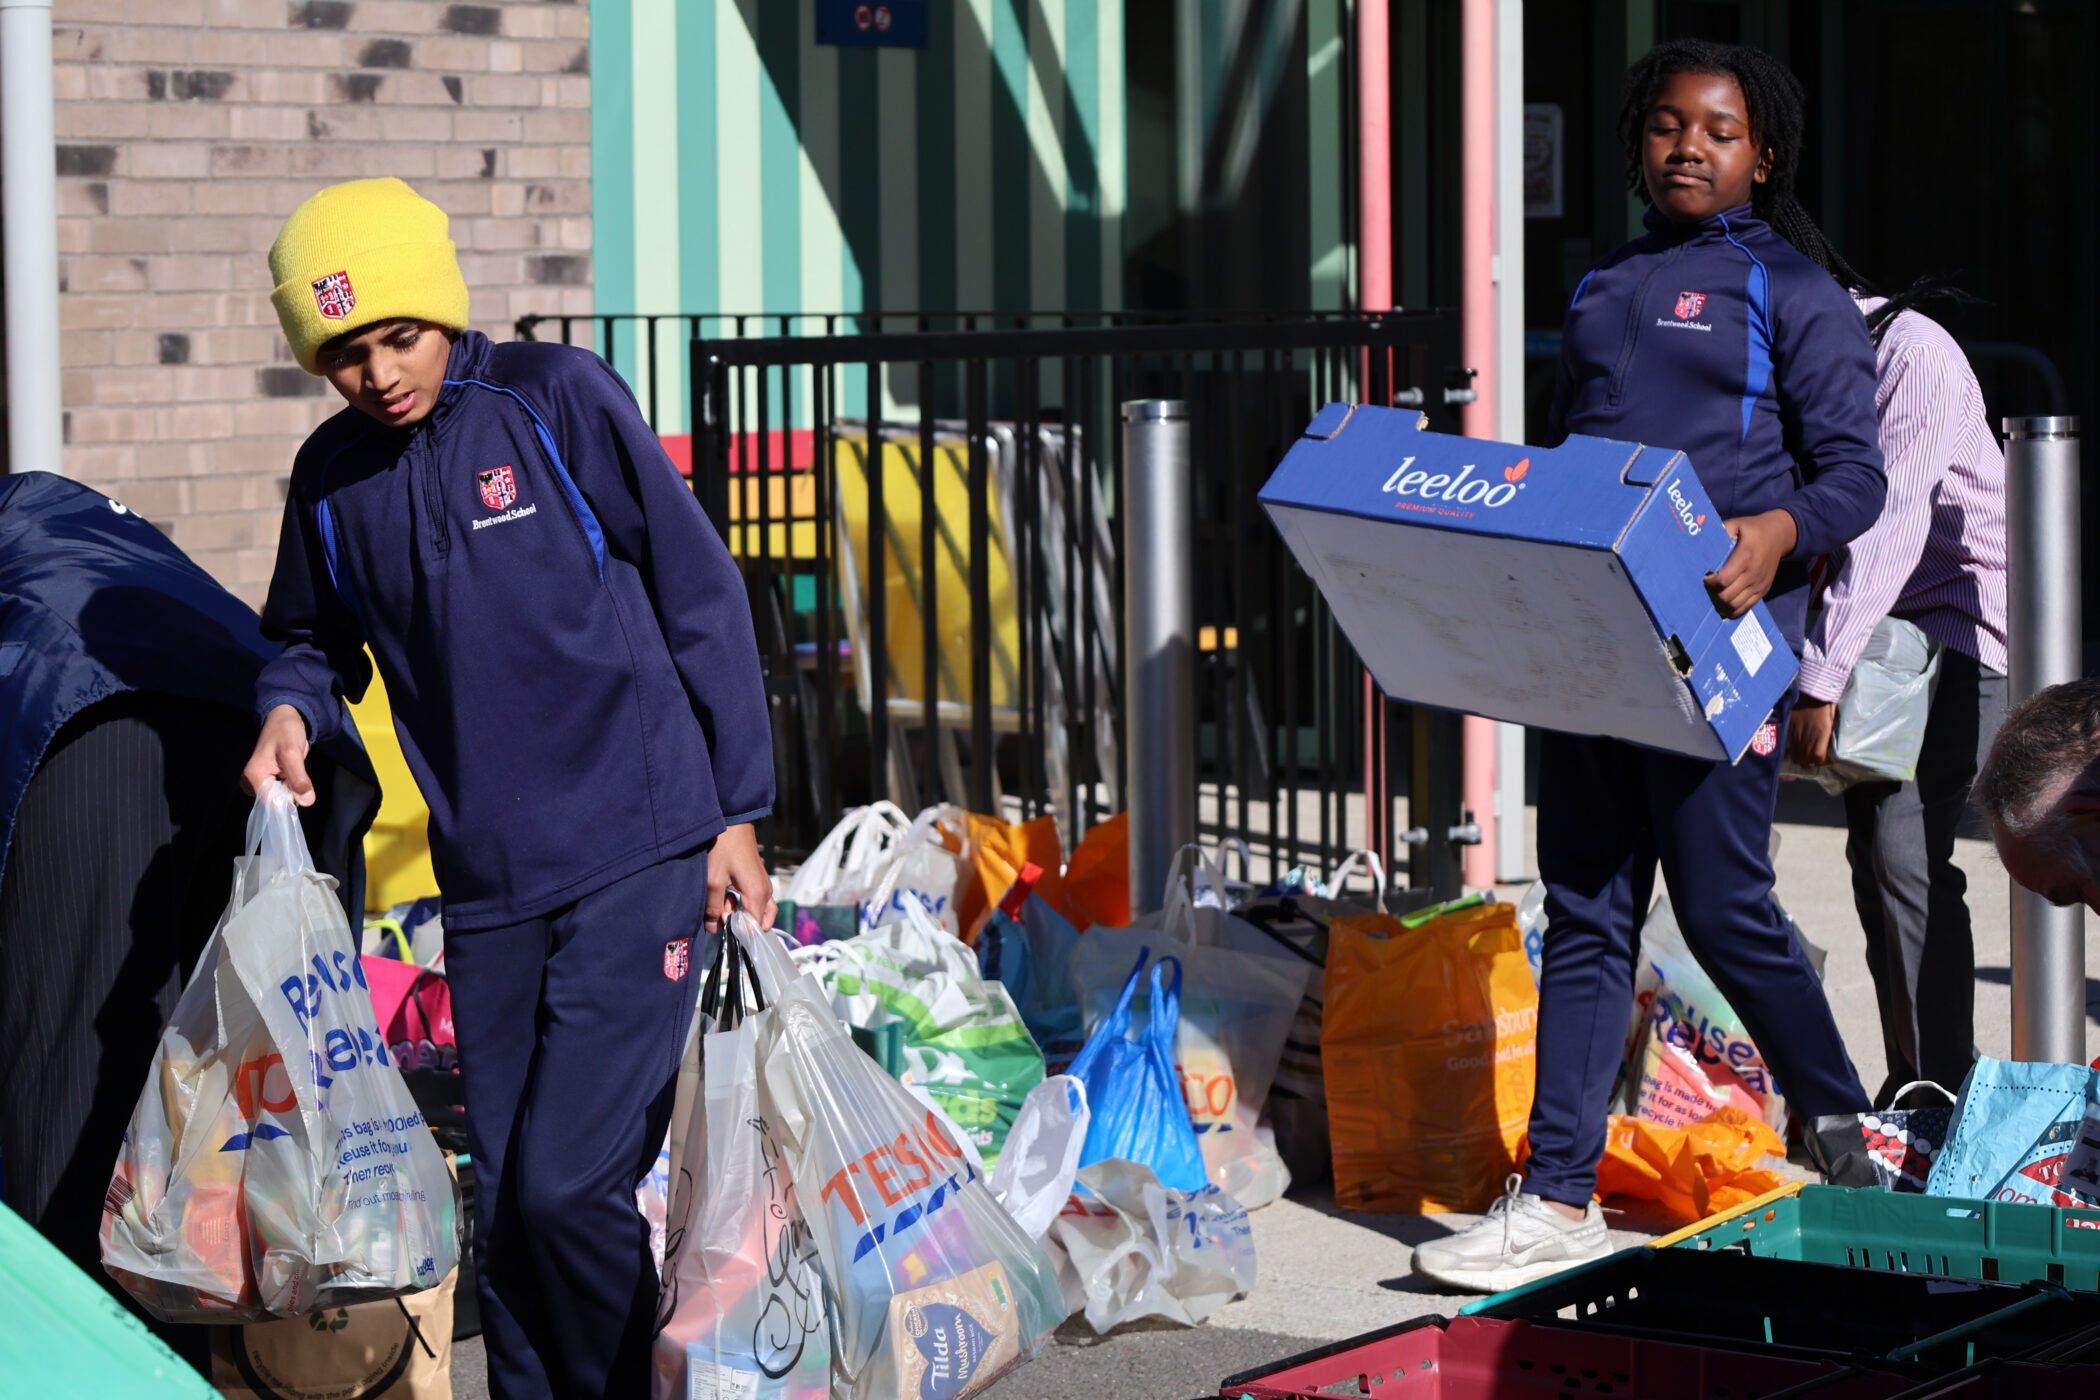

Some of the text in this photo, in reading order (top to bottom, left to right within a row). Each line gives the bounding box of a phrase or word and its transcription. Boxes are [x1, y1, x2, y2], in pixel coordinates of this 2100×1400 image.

[1688, 321, 1712, 332] School
[1382, 456, 1517, 508] leeloo
[472, 503, 537, 530] Brentwood School
[1395, 501, 1475, 519] PREMIUM QUALITY
[1667, 478, 1699, 536] leeloo
[280, 950, 368, 1040] Res
[1447, 1050, 1490, 1071] Good
[1658, 1096, 1674, 1109] for
[1675, 1105, 1687, 1115] as
[1664, 1081, 1673, 1093] is
[1674, 1088, 1704, 1106] made
[1637, 1104, 1675, 1126] recycle
[352, 1121, 374, 1137] bag
[821, 1110, 963, 1227] TES
[363, 1192, 382, 1206] out
[954, 1312, 970, 1380] Mushroom
[931, 1327, 950, 1392] Tilda
